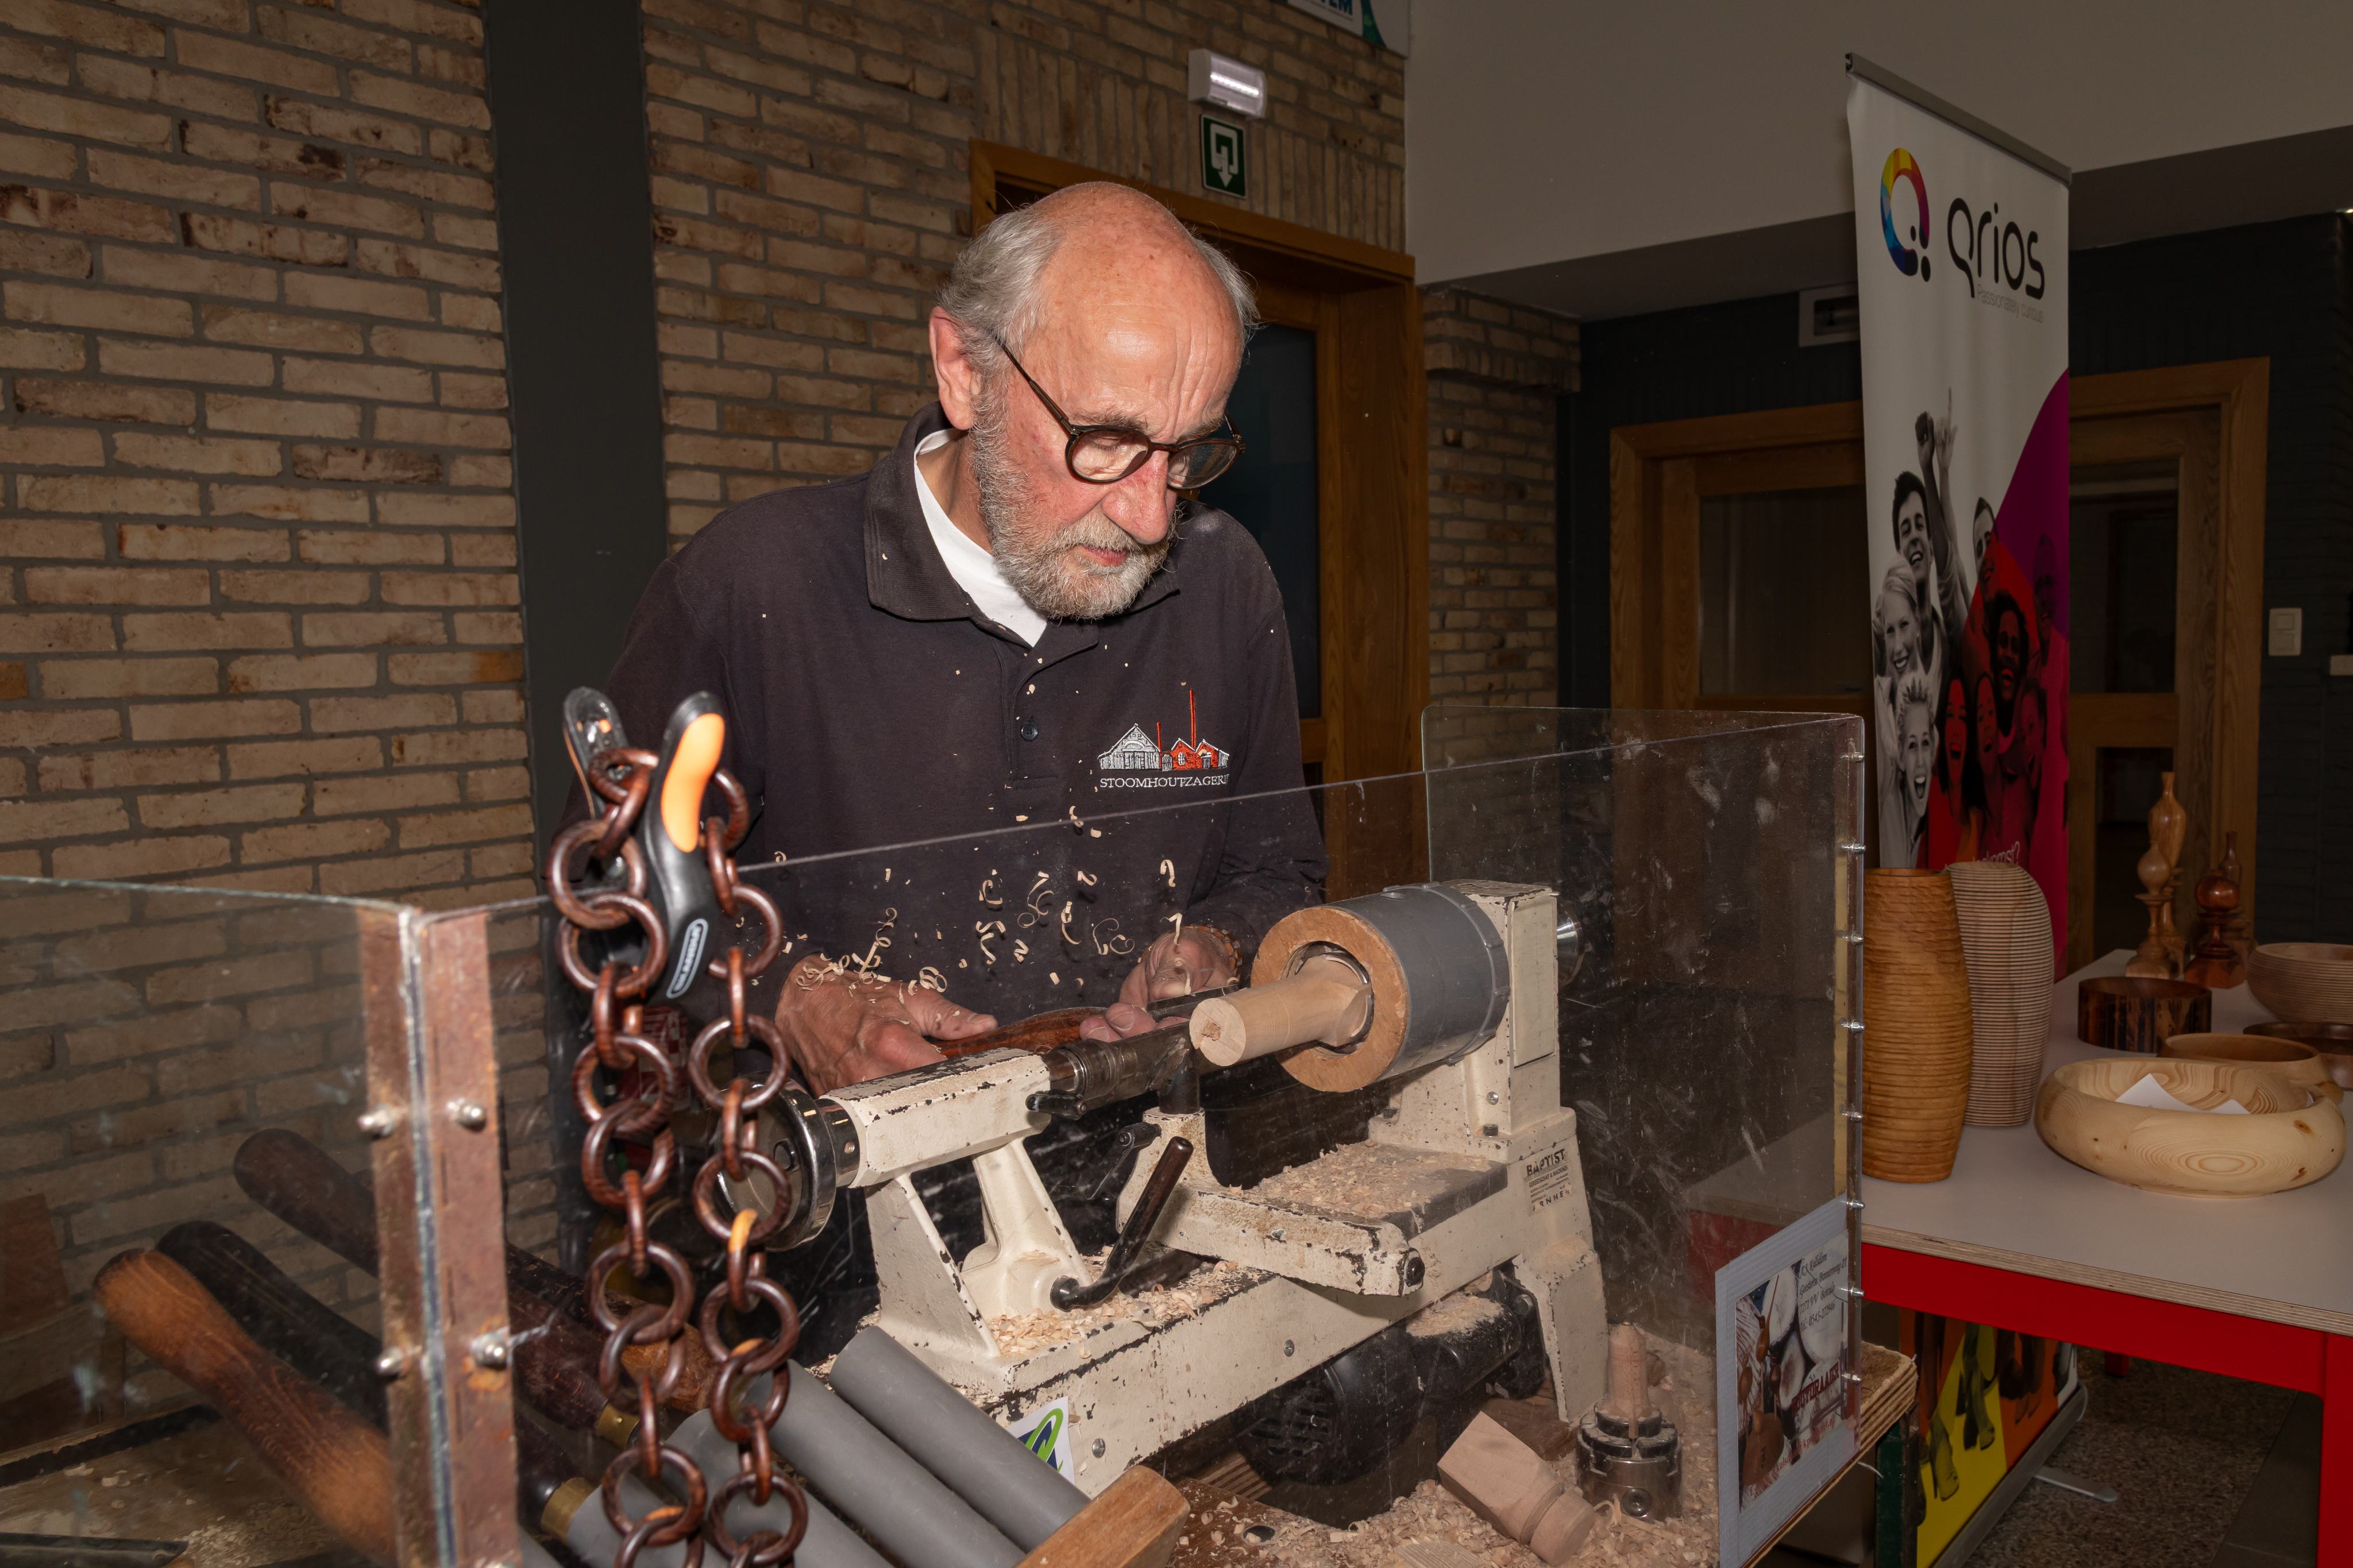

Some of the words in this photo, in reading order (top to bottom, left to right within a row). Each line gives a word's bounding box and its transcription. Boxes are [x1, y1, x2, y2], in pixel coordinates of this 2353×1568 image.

[1977, 284, 2019, 319] Passionately
[2022, 303, 2044, 323] curious
[1526, 1149, 1565, 1177] BAPTIST
